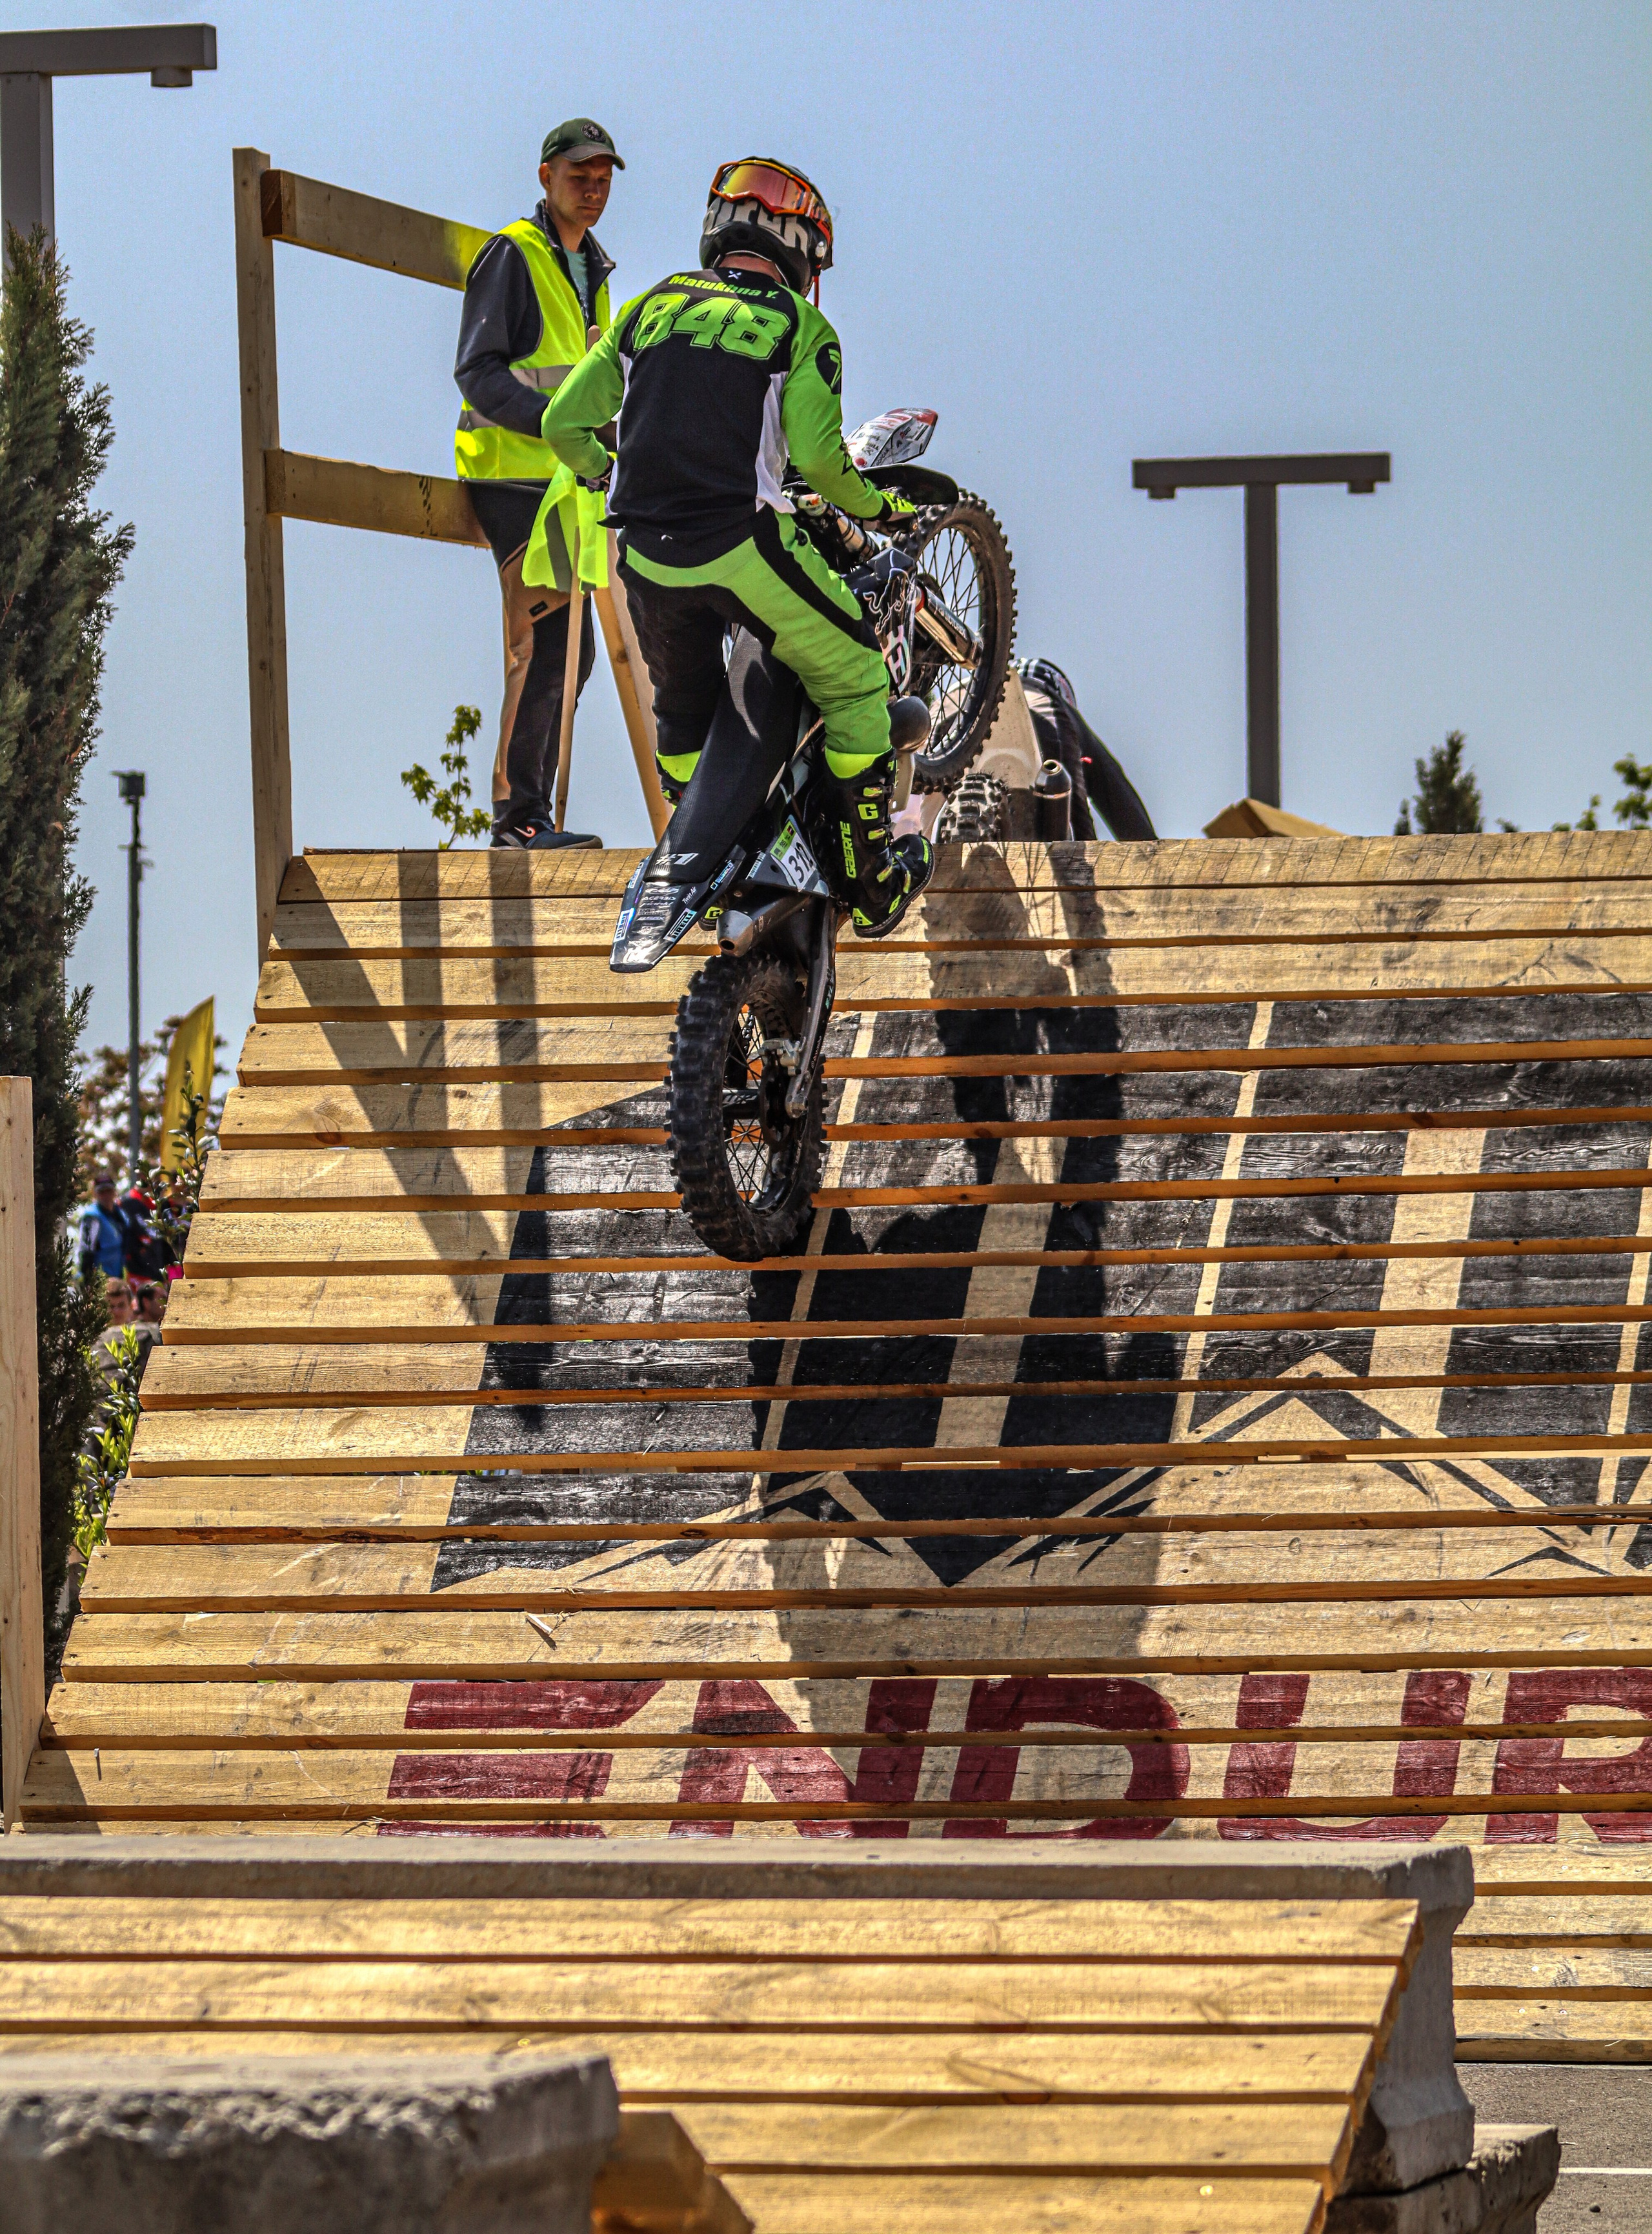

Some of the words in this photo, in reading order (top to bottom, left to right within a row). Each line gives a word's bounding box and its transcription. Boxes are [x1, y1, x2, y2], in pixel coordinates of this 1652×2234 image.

[632, 292, 791, 360] 848
[656, 852, 699, 865] #1
[788, 841, 814, 883] 312
[681, 892, 692, 904] Twin
[669, 911, 694, 940] PIRELLI
